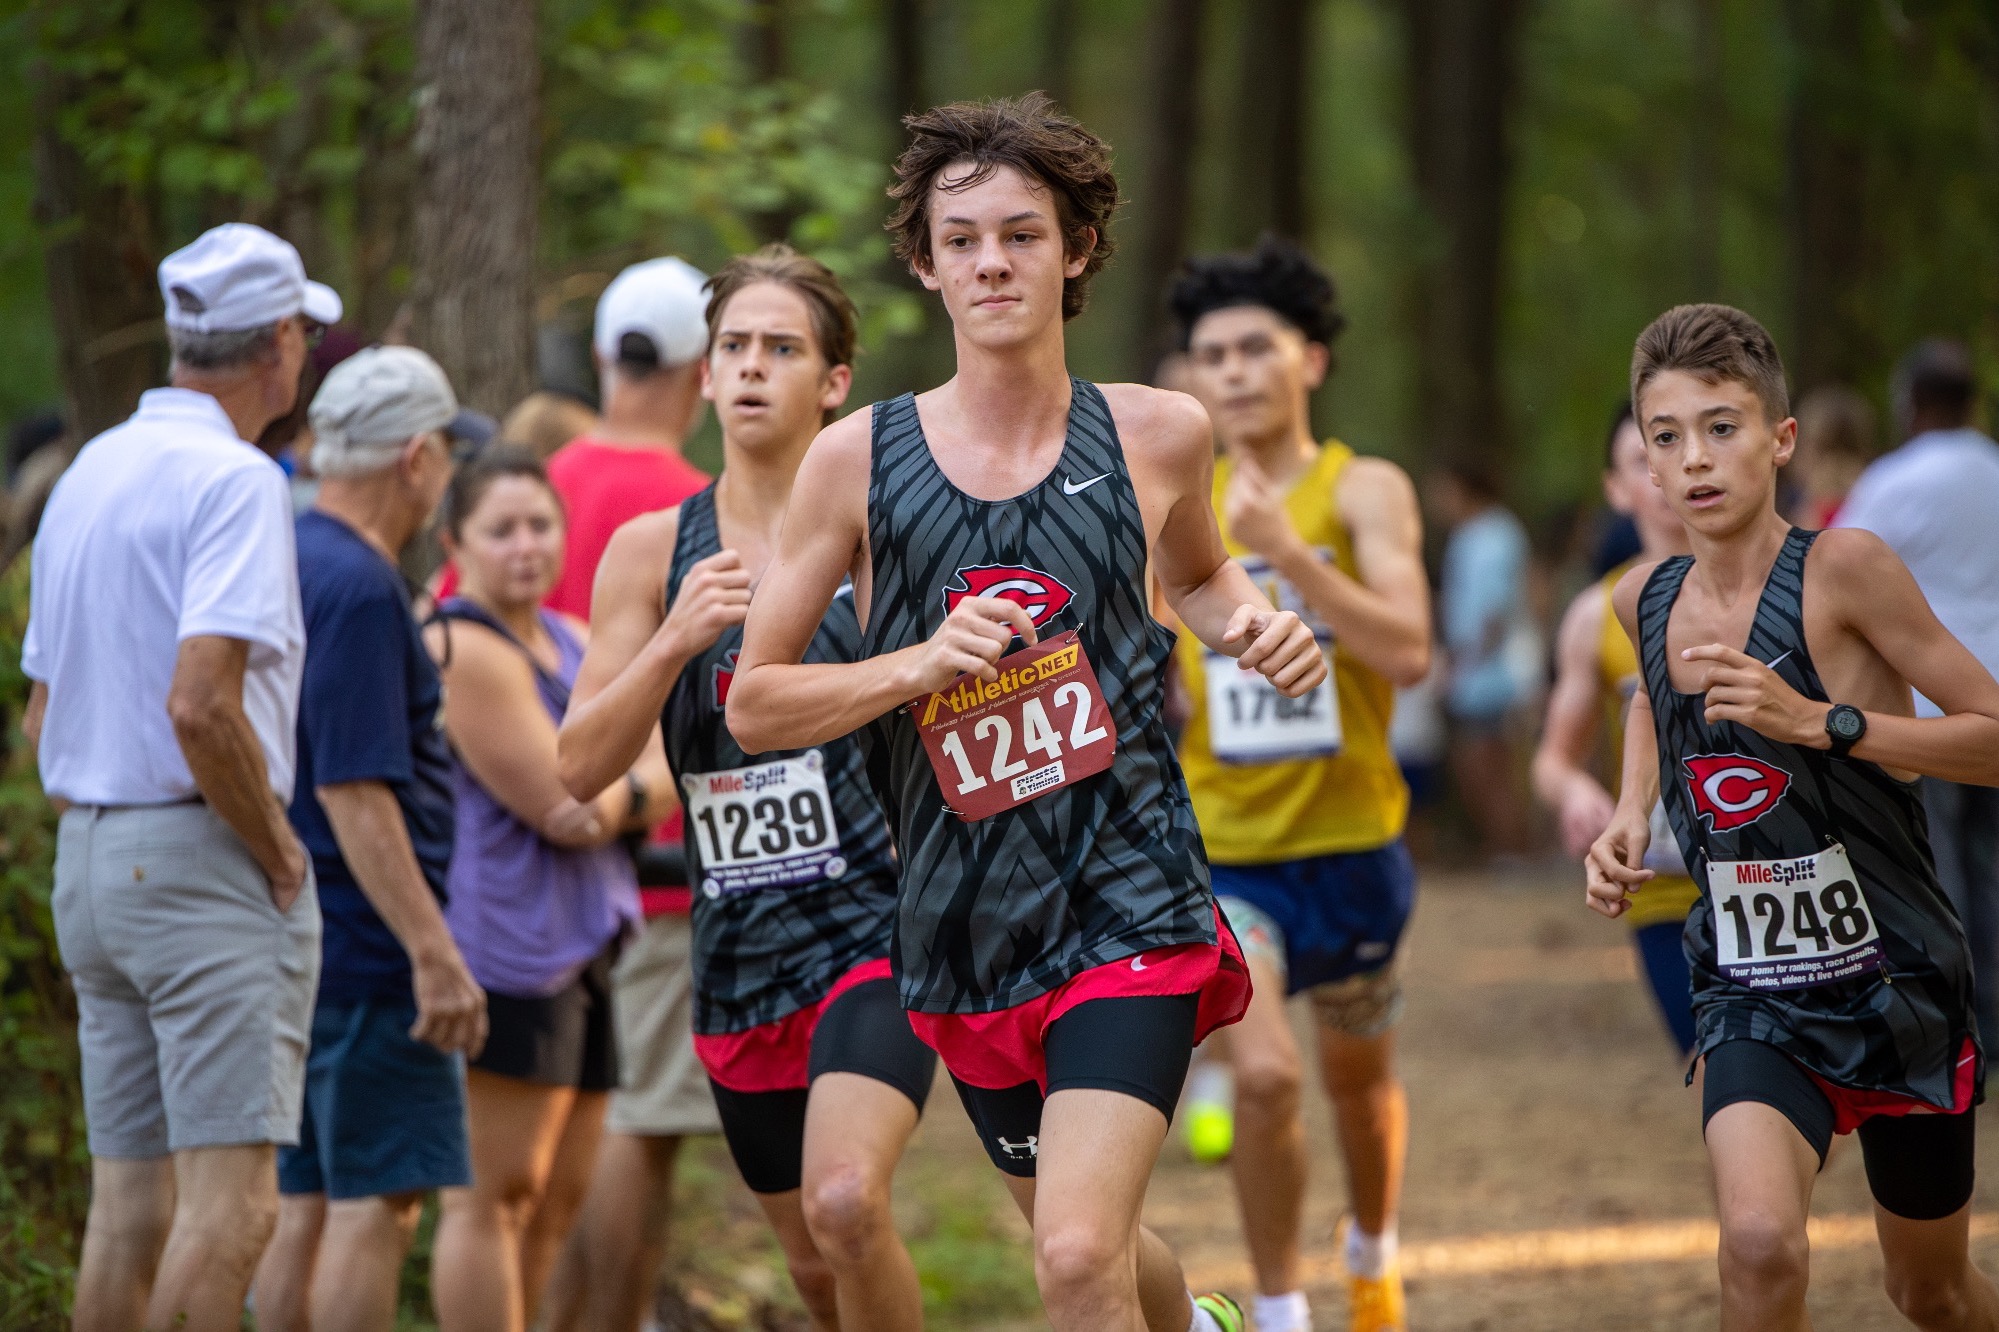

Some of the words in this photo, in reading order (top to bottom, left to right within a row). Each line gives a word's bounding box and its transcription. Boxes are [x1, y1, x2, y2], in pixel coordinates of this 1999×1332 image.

[942, 681, 1108, 795] 1242
[709, 765, 787, 793] MileSplit
[1027, 775, 1060, 792] Timing
[1703, 767, 1769, 813] C
[698, 789, 827, 861] 1239
[1736, 858, 1816, 886] MileSplit
[1722, 879, 1869, 959] 1248
[1730, 967, 1750, 977] Your
[1751, 966, 1775, 976] home
[1776, 964, 1788, 973] for
[1789, 961, 1824, 973] rankings,
[1825, 958, 1845, 969] race
[1846, 945, 1878, 963] results,
[1750, 977, 1780, 989] photos,
[1782, 975, 1807, 985] videos
[1808, 973, 1816, 982] &
[1817, 970, 1832, 980] live
[1834, 963, 1863, 978] events
